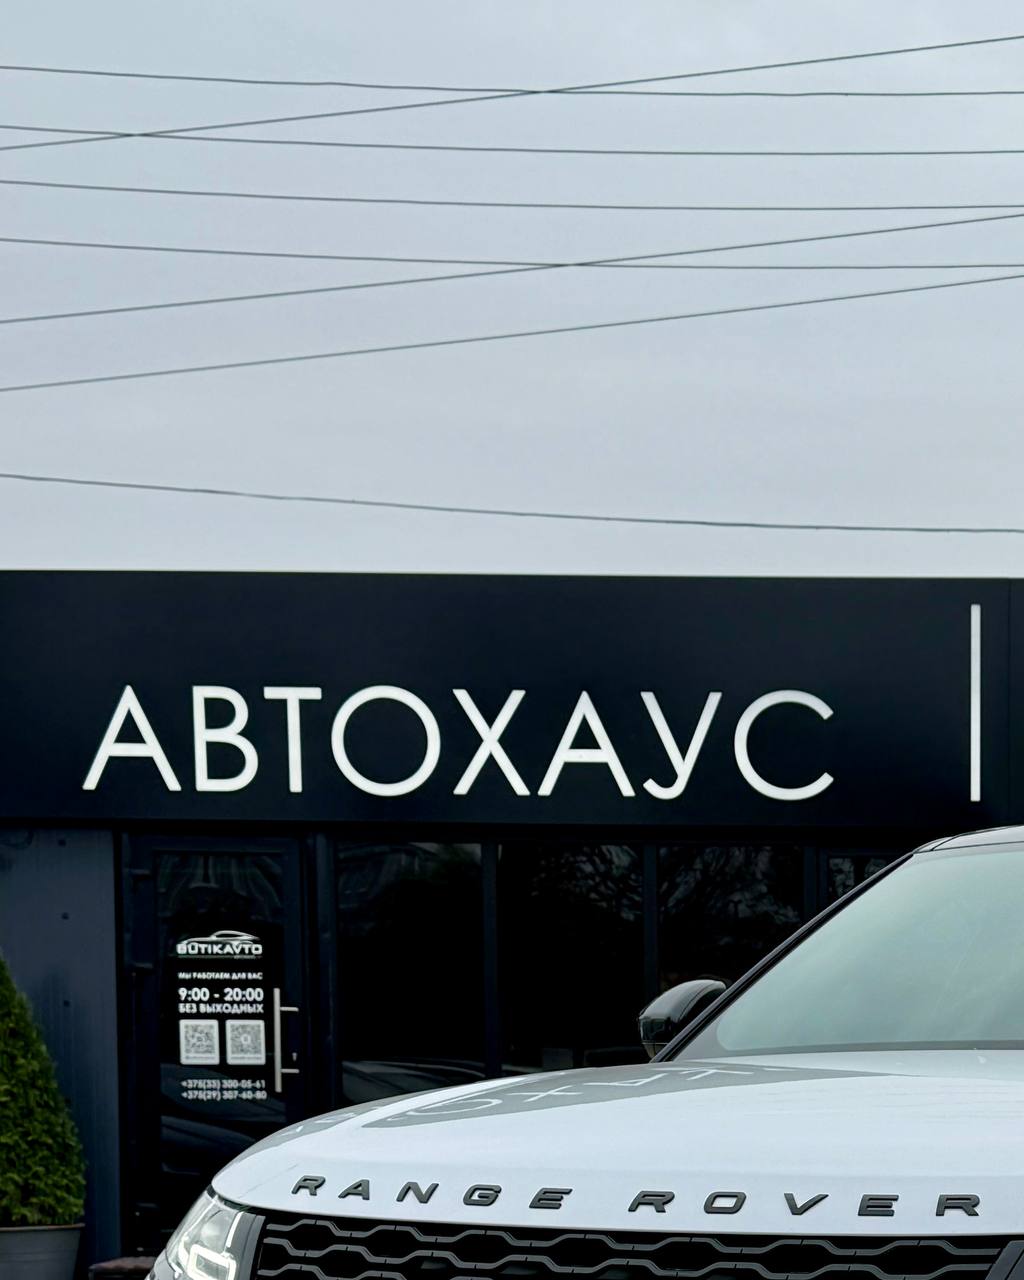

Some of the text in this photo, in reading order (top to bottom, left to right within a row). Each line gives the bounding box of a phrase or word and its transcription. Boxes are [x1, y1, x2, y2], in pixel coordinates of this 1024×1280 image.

[82, 684, 834, 801] АВТОХАУС
[176, 943, 263, 955] BUTIKAVTO
[178, 987, 210, 1002] 9:00
[223, 988, 264, 1002] 20:00
[179, 1003, 264, 1014] БЕЗ ВЫХОДНЫХ
[291, 1175, 981, 1217] RANGE ROVER
